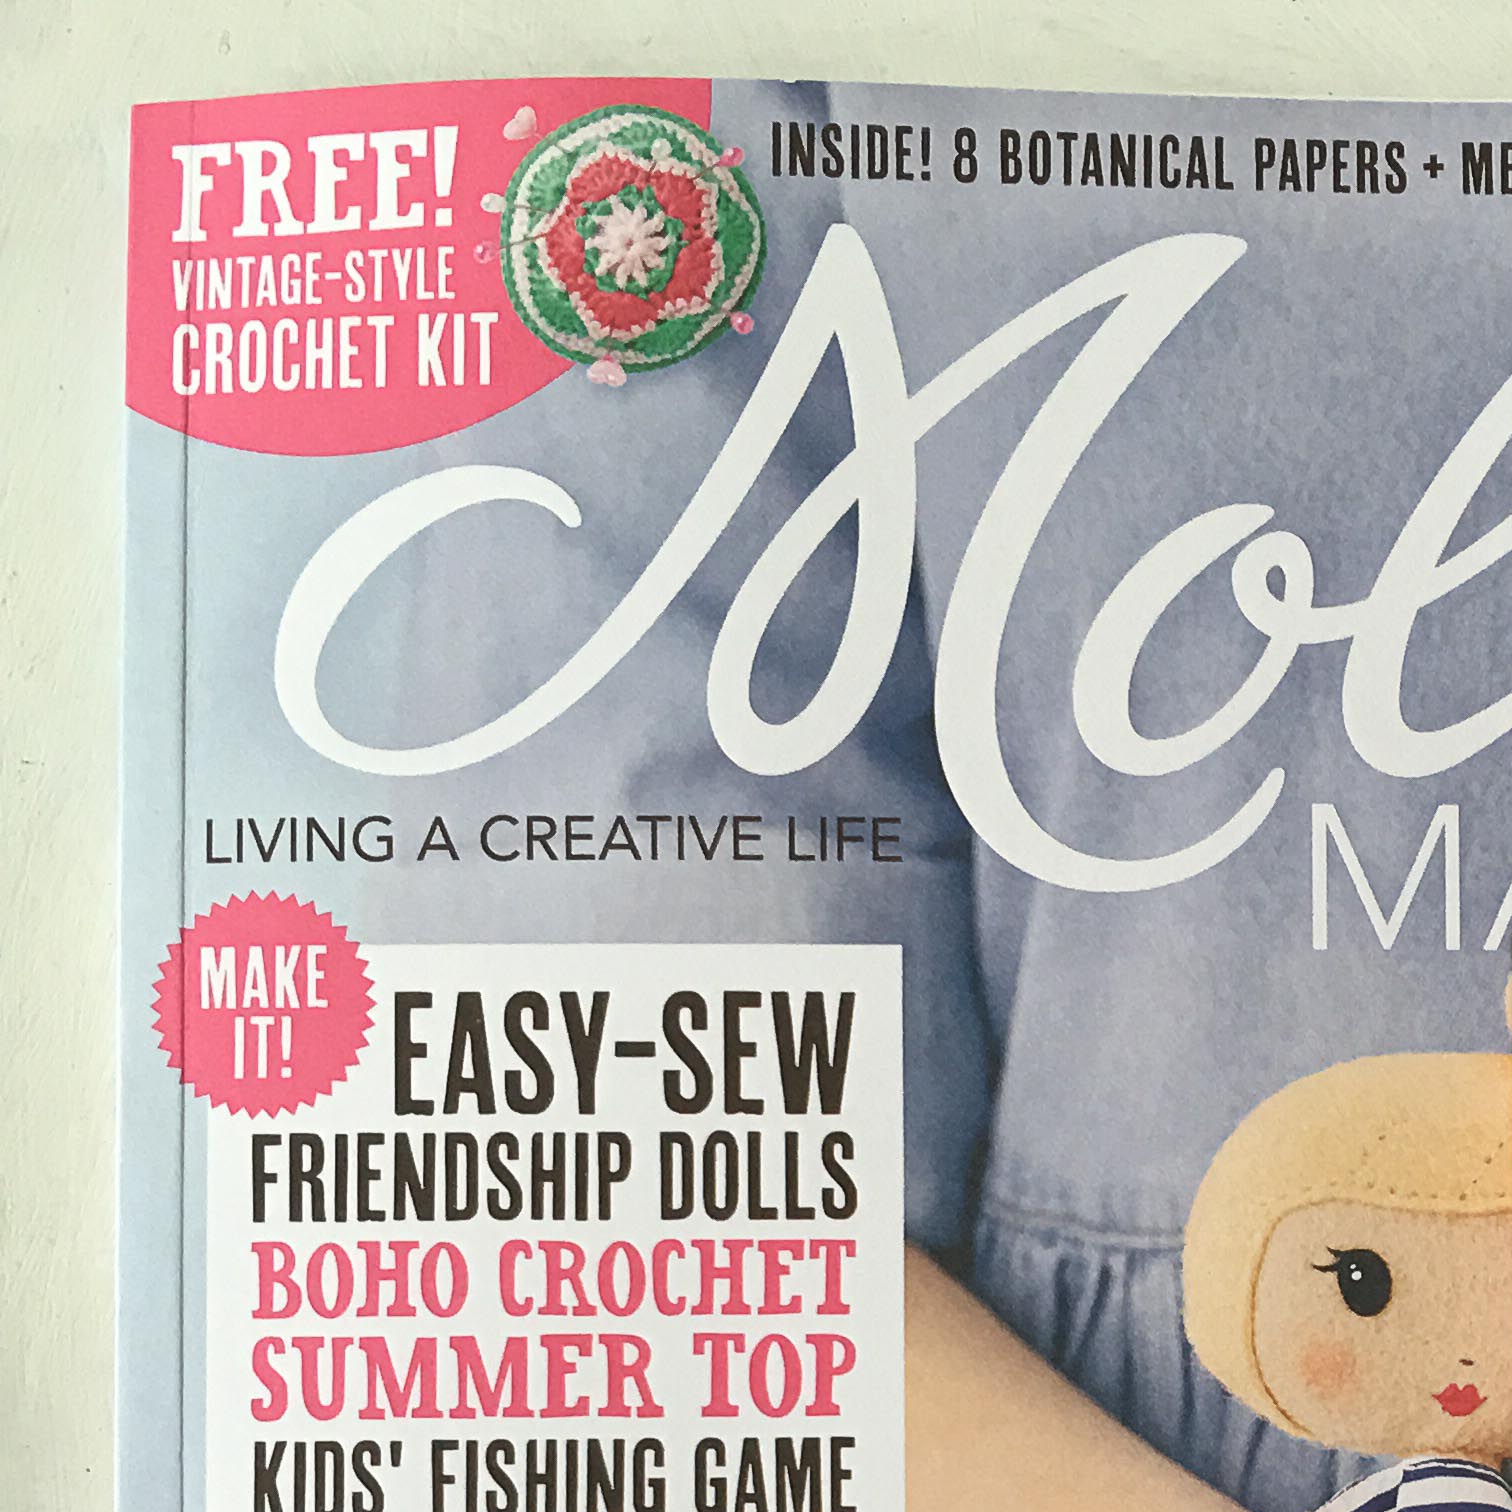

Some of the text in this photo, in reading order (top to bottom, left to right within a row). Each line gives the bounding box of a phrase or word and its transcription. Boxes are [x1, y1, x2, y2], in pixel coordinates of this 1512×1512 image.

[172, 125, 459, 242] FREE!
[771, 121, 931, 181] INSIDE!
[953, 127, 978, 183] 8
[1000, 129, 1234, 190] BOTANICAL
[1255, 137, 1408, 194] PAPERS
[172, 246, 455, 311] VINTAGE-STYLE
[172, 312, 499, 396] CROCHET KIT
[206, 815, 903, 863] LIVING A CREATIVE LIFE
[199, 944, 329, 1010] MAKE
[233, 1016, 293, 1080] IT!
[394, 991, 856, 1116] EASY-SEW
[250, 1131, 857, 1223] FRIENDSHIP DOLLS
[251, 1238, 857, 1319] BOHO CROCHET
[250, 1333, 857, 1422] SUMMER TOP
